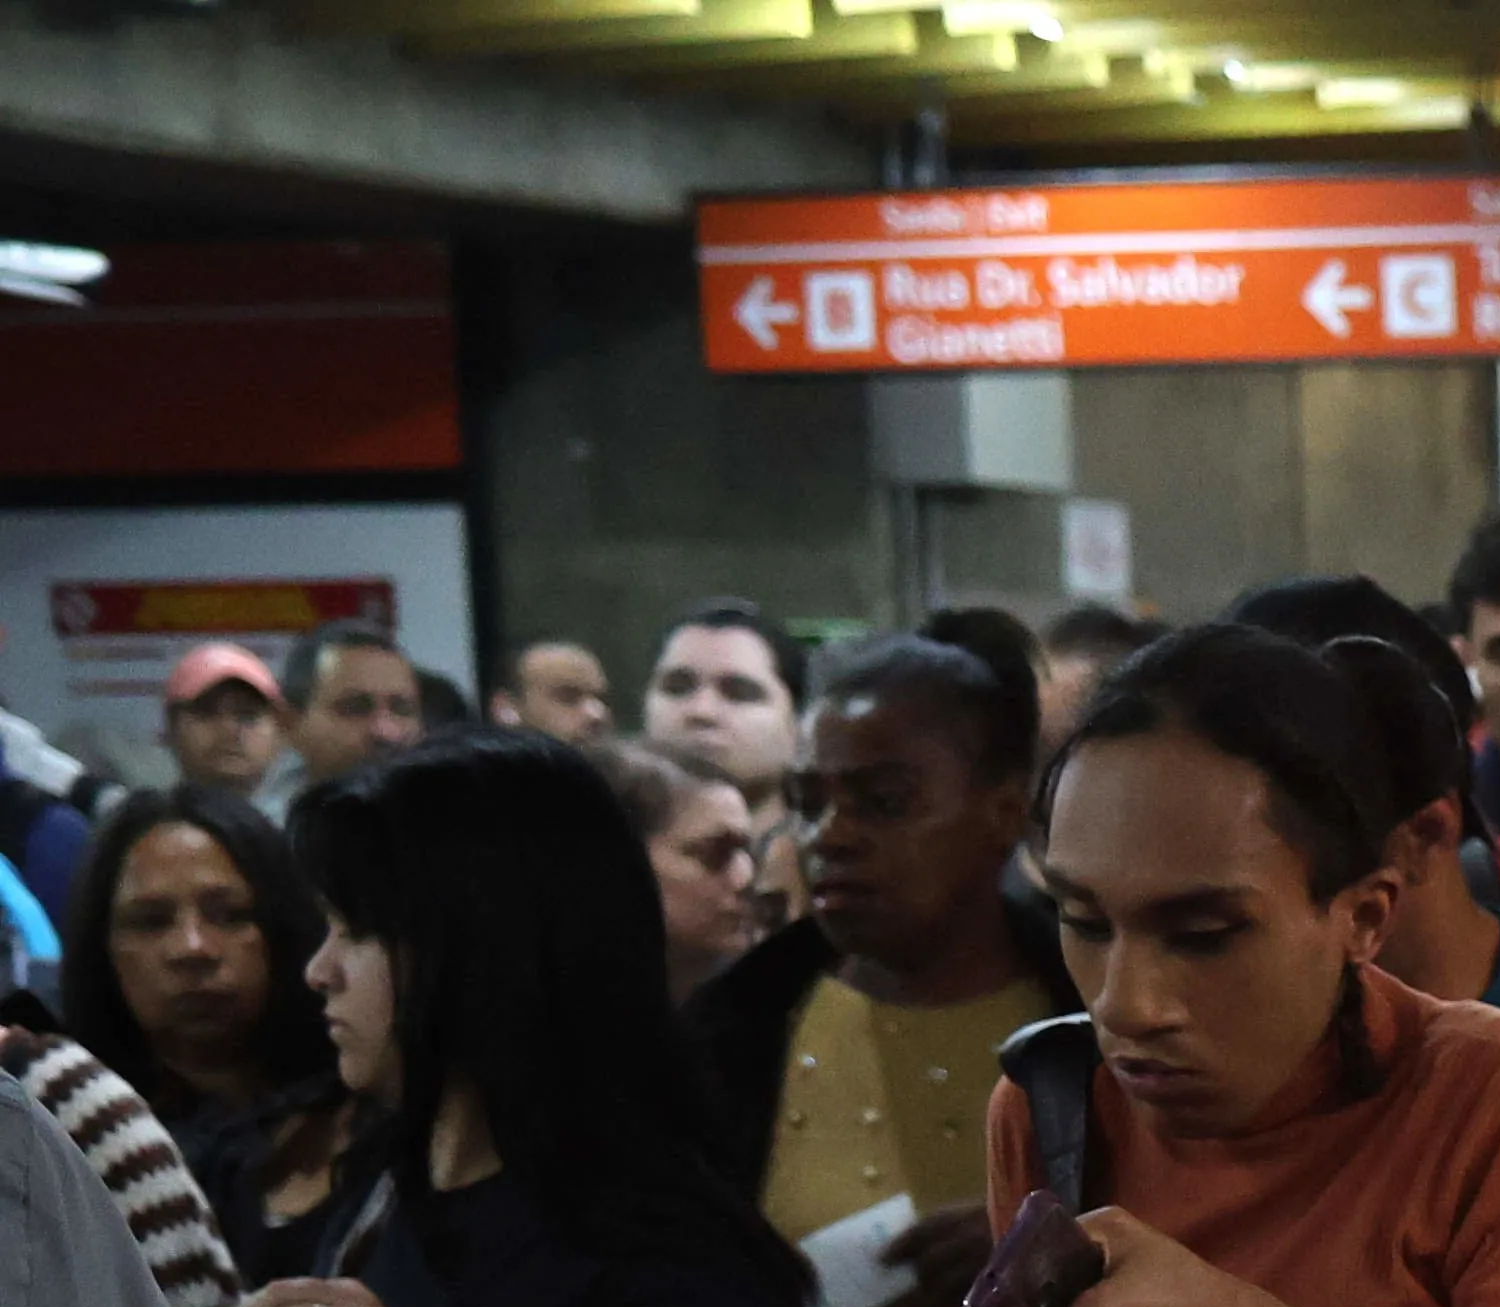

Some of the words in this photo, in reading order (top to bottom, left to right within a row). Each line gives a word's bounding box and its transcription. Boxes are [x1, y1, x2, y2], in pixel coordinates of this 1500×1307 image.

[882, 262, 970, 309] Rua
[973, 258, 1042, 308] Dr.
[1046, 250, 1246, 308] Salvador
